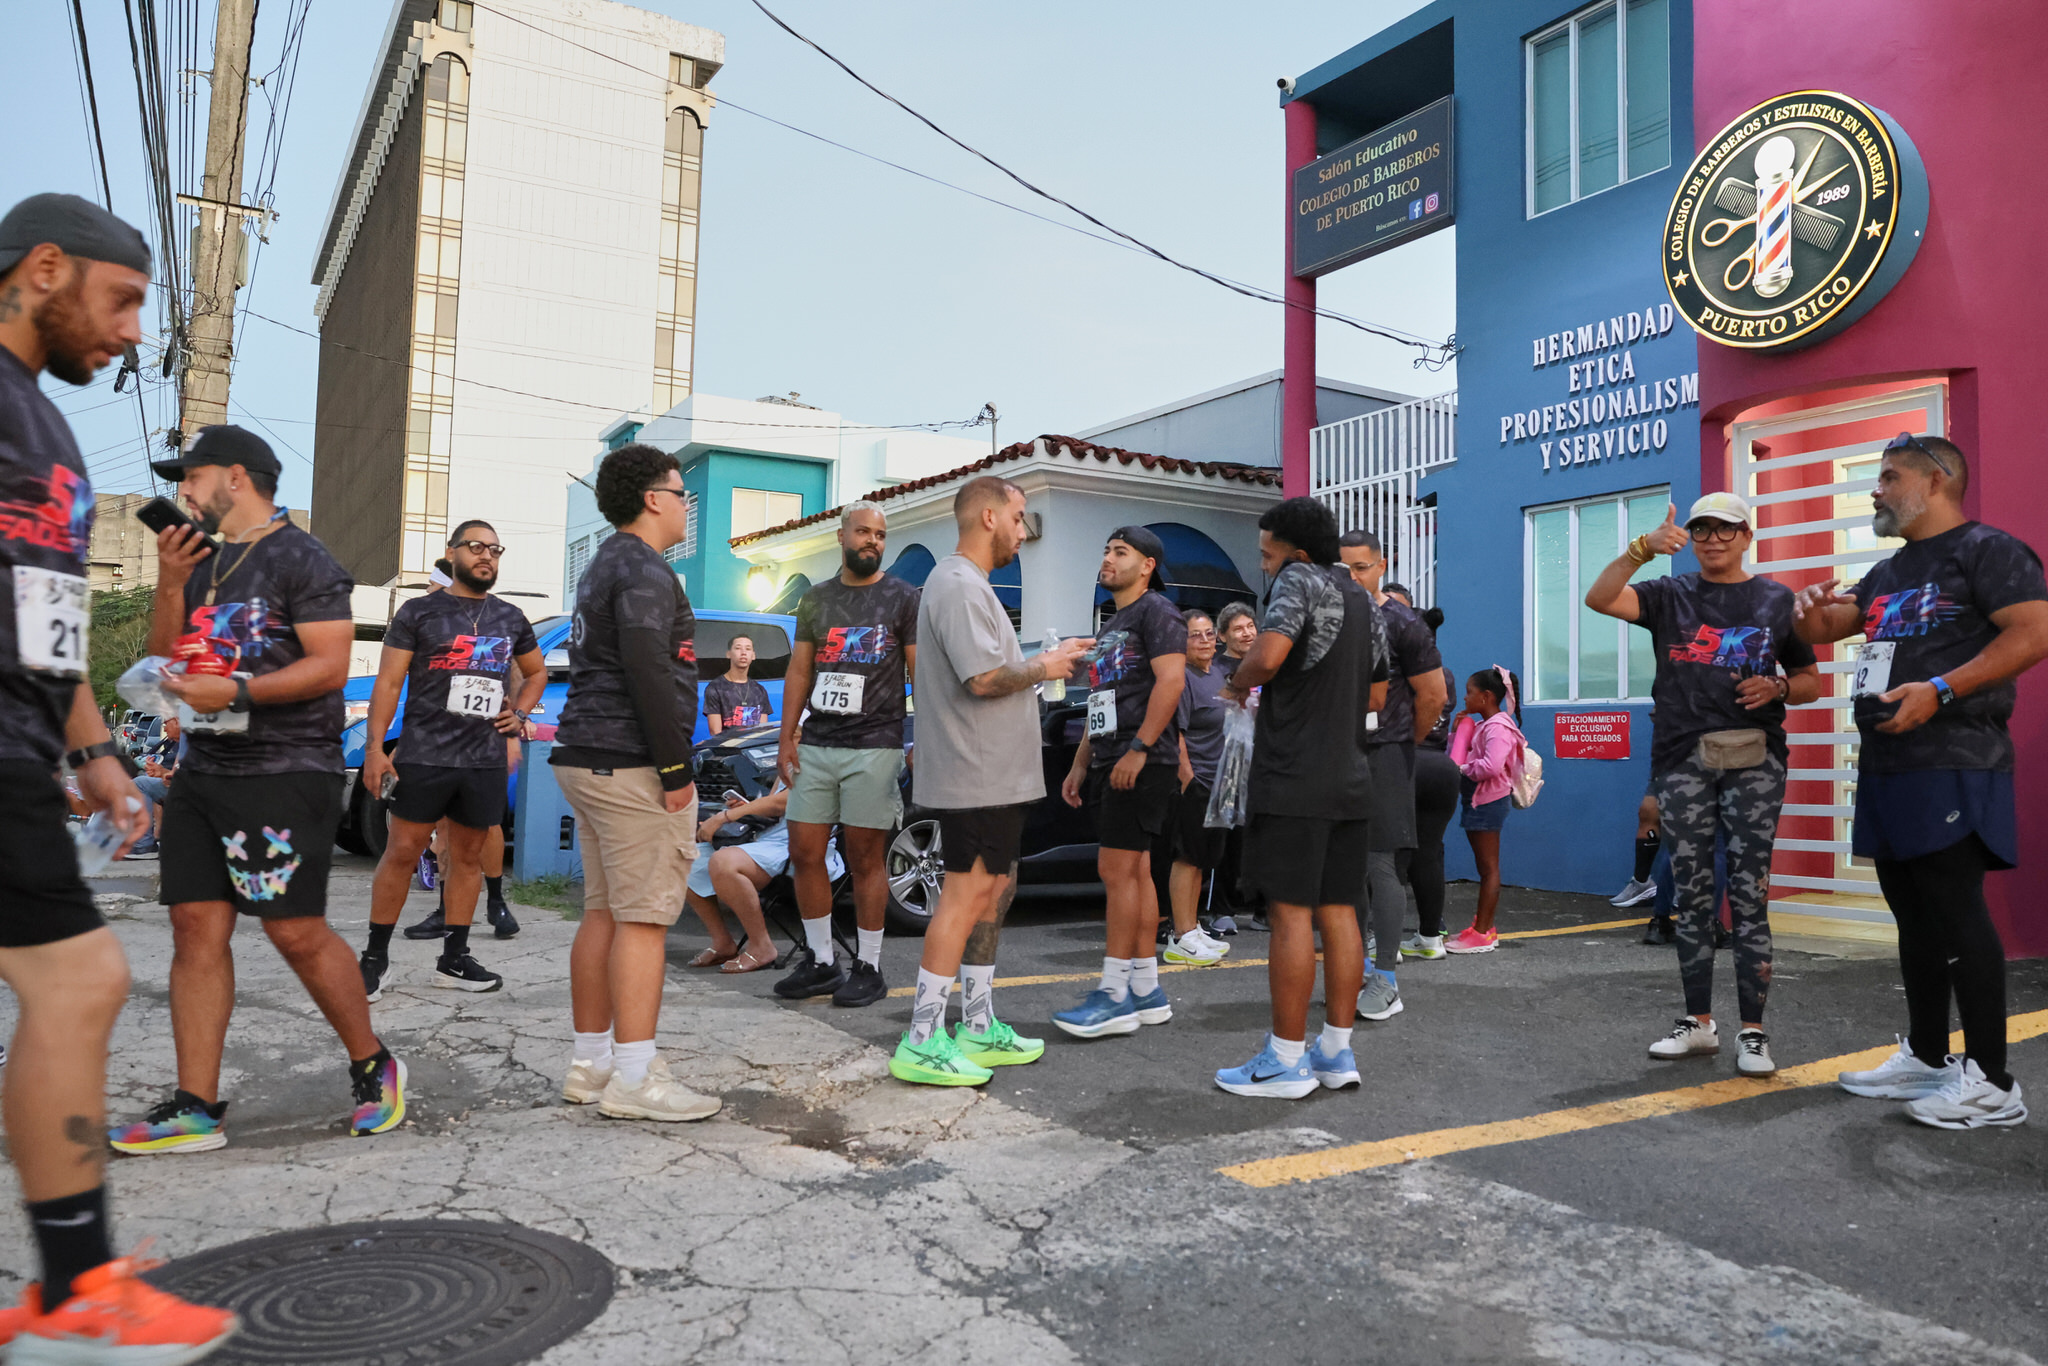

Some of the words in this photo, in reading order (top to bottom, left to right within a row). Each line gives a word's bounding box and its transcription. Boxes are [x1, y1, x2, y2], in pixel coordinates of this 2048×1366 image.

[1318, 159, 1352, 184] Salón
[1355, 128, 1418, 168] Educativo
[1299, 183, 1351, 216] COLEGIO
[1353, 174, 1370, 194] DE
[1373, 143, 1441, 185] BARBEROS
[1671, 196, 1694, 262] COLEGIO
[1688, 177, 1705, 198] DE
[1699, 117, 1762, 180] BARBEROS
[1761, 111, 1772, 126] Y
[1773, 103, 1845, 125] ESTILISTAS
[1843, 113, 1862, 135] EN
[1854, 129, 1889, 200] BARBERÍA
[1316, 215, 1332, 233] DE
[1335, 192, 1384, 224] PUERTO
[1387, 176, 1420, 203] RICO
[1816, 184, 1850, 207] 1989
[1697, 306, 1788, 338] PUERTO
[1795, 276, 1852, 327] RICO
[1533, 303, 1674, 367] HERMANDAD
[1569, 350, 1636, 393] ETICA
[1500, 372, 1700, 443] PROFESIONALISM
[1540, 441, 1554, 471] Y
[1559, 418, 1668, 467] SERVICIO
[1864, 588, 1919, 628] 5K
[447, 634, 505, 661] 5K
[824, 627, 875, 653] 5K
[1686, 623, 1761, 657] 5K
[428, 659, 470, 671] FADE
[468, 660, 480, 671] &
[1669, 649, 1714, 665] FADE
[1712, 655, 1726, 667] &
[463, 693, 492, 713] 121
[821, 690, 850, 709] 175
[1090, 711, 1106, 731] 69
[1556, 715, 1628, 724] ESTACIONAMIENTO
[1570, 724, 1613, 733] EXCLUSIVO
[1561, 734, 1579, 743] PARA
[1580, 734, 1622, 743] COLEGIADOS
